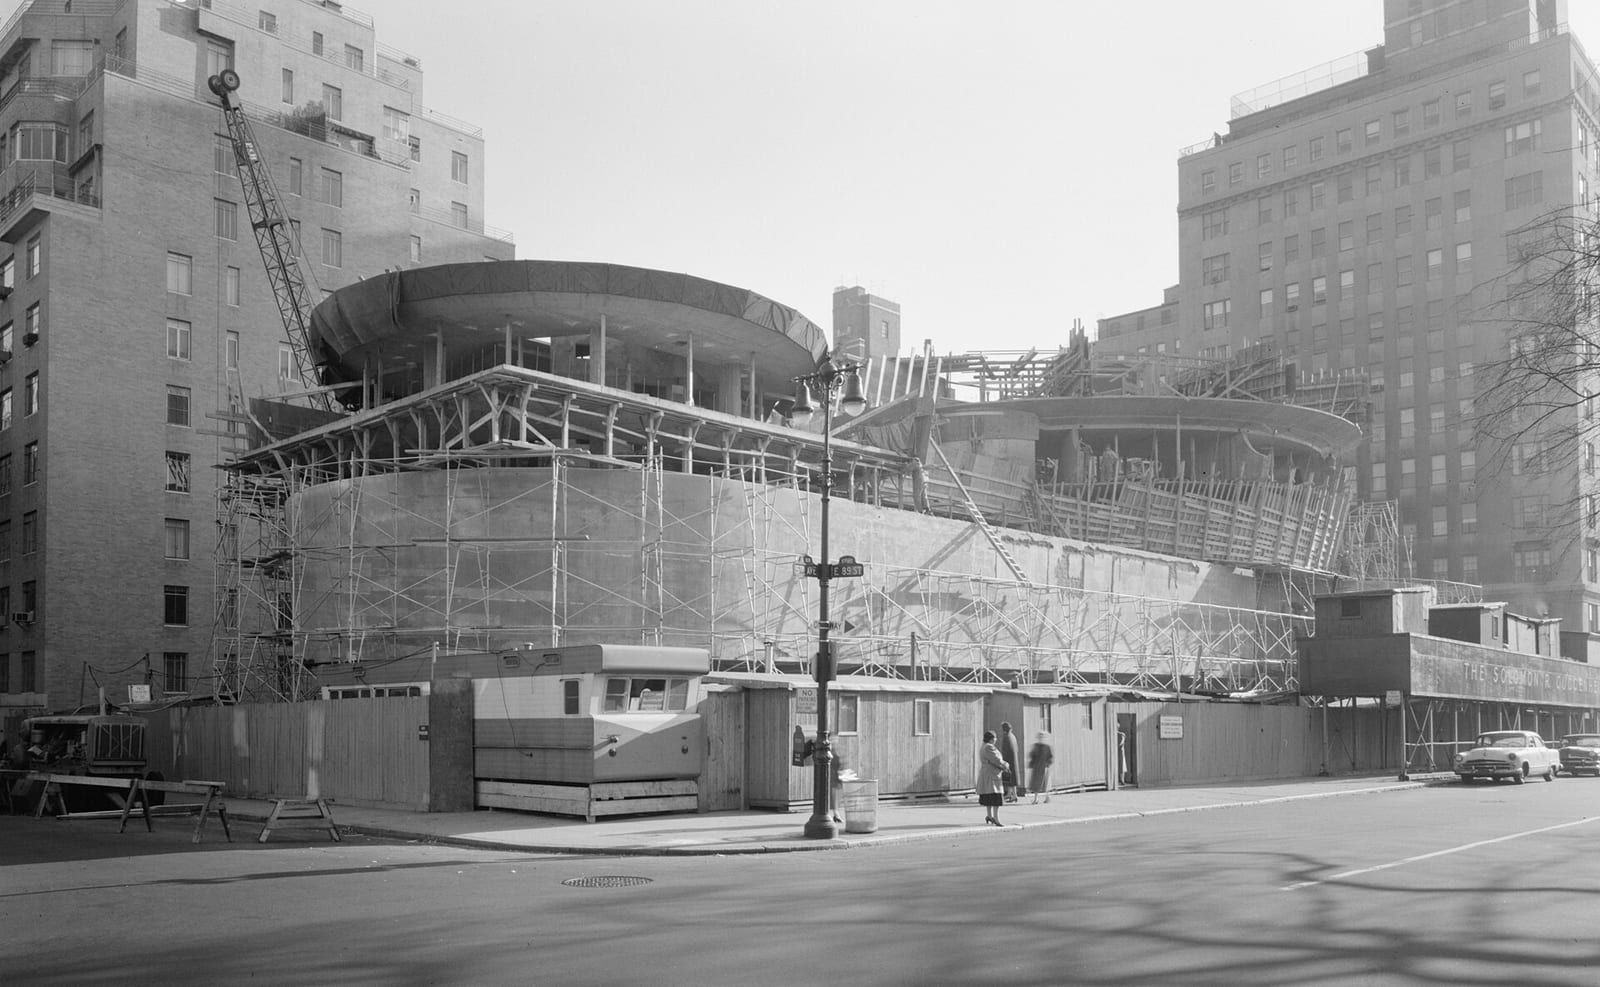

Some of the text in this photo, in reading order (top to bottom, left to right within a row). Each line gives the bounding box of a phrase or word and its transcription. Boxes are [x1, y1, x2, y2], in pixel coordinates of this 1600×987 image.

[834, 565, 862, 576] E 89 ST
[1464, 662, 1485, 681] THE
[1493, 667, 1539, 687] SOLOMON
